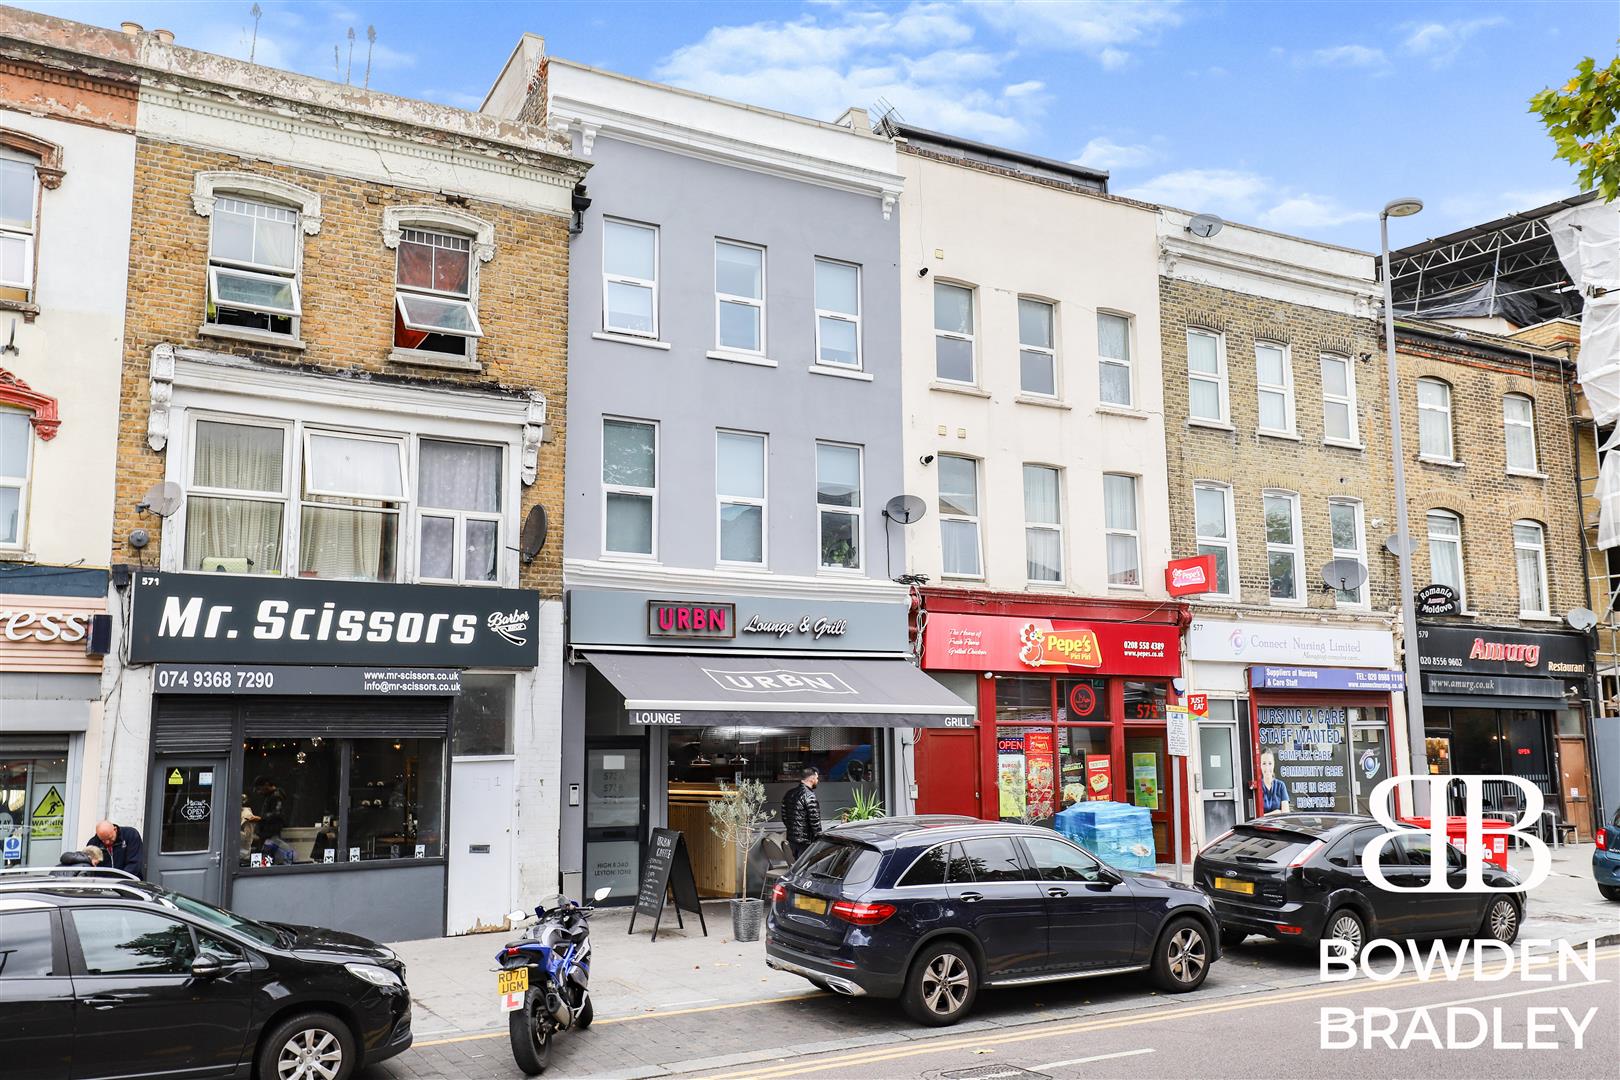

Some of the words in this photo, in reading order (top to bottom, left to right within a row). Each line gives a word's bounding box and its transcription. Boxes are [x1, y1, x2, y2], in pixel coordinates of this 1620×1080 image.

[141, 577, 160, 586] 571
[1419, 586, 1453, 600] Romania
[1422, 603, 1453, 614] Moldova
[157, 596, 239, 639] Mr.
[253, 599, 479, 645] Scissors
[487, 609, 530, 628] Barber
[658, 607, 726, 632] URBN
[743, 614, 794, 638] Lounge
[798, 616, 811, 633] &
[813, 617, 848, 640] Grill
[1193, 624, 1204, 632] 577
[1418, 630, 1429, 639] 579
[1047, 634, 1092, 656] Pepe's
[1123, 641, 1138, 649] 0208
[1139, 642, 1150, 650] 558
[1150, 642, 1165, 650] 4389
[1250, 635, 1288, 649] Connect
[1292, 637, 1326, 653] Nursing
[1329, 639, 1361, 653] Limited
[1070, 652, 1081, 660] Piri
[1081, 653, 1091, 661] Piri
[1123, 650, 1164, 658] www.pepes.co.uk
[1469, 637, 1541, 668] Amurg
[1419, 656, 1432, 665] 020
[1432, 657, 1448, 667] 8556
[1448, 658, 1463, 667] 9602
[1547, 661, 1585, 673] Restaurant
[158, 670, 188, 688] 074
[193, 671, 232, 688] 9368
[236, 671, 274, 689] 7290
[364, 671, 459, 681] www.mr-scissors.co.uk
[724, 673, 836, 690] URBN
[364, 681, 461, 693] info@mr-scissors.co.uk
[1430, 679, 1495, 691] www.amurg.co.uk
[1136, 702, 1159, 718] 575
[1193, 703, 1205, 711] EAT
[635, 712, 682, 724] LOUNGE
[944, 716, 971, 728] GRILL
[1306, 709, 1314, 724] &
[1317, 710, 1346, 725] CARE
[1259, 728, 1293, 744] STAFF
[1295, 729, 1342, 745] WANTED
[998, 740, 1023, 750] OPEN
[1278, 749, 1313, 761] COMPLEX
[1313, 750, 1333, 761] CARE
[1280, 766, 1325, 777] COMMUNITY
[1324, 766, 1344, 777] CARE
[1291, 782, 1308, 793] LIVE
[1308, 782, 1317, 793] IN
[1317, 782, 1337, 793] CARE
[1296, 796, 1336, 809] HOSPITALS
[186, 808, 206, 816] OPEN
[501, 980, 525, 994] UGM
[506, 991, 519, 1008] L
